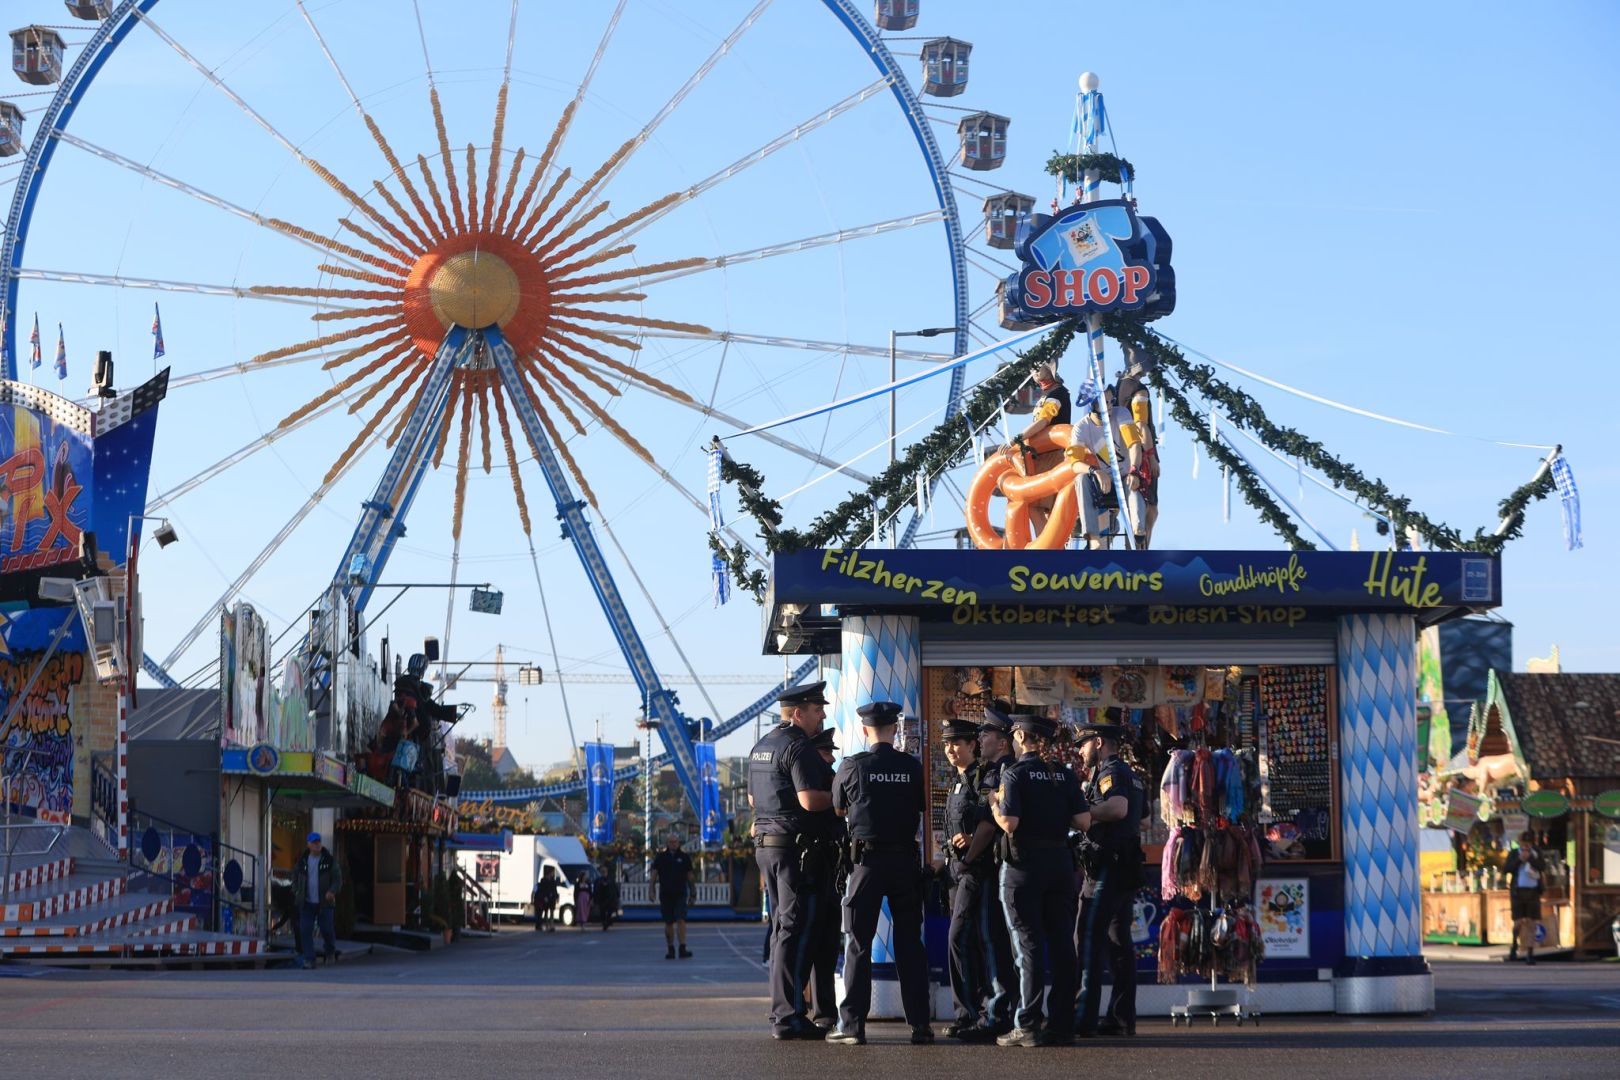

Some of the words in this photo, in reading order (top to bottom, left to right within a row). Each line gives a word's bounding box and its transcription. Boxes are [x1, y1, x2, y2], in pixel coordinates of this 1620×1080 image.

[1024, 265, 1150, 308] SHOP
[821, 548, 977, 605] Filzherzen
[1008, 565, 1163, 593] Souvenirs
[1363, 551, 1443, 608] Hüte
[952, 603, 1117, 628] Oktoberfest
[1148, 605, 1307, 628] Wiesn-Shop
[869, 773, 911, 783] POLIZEI
